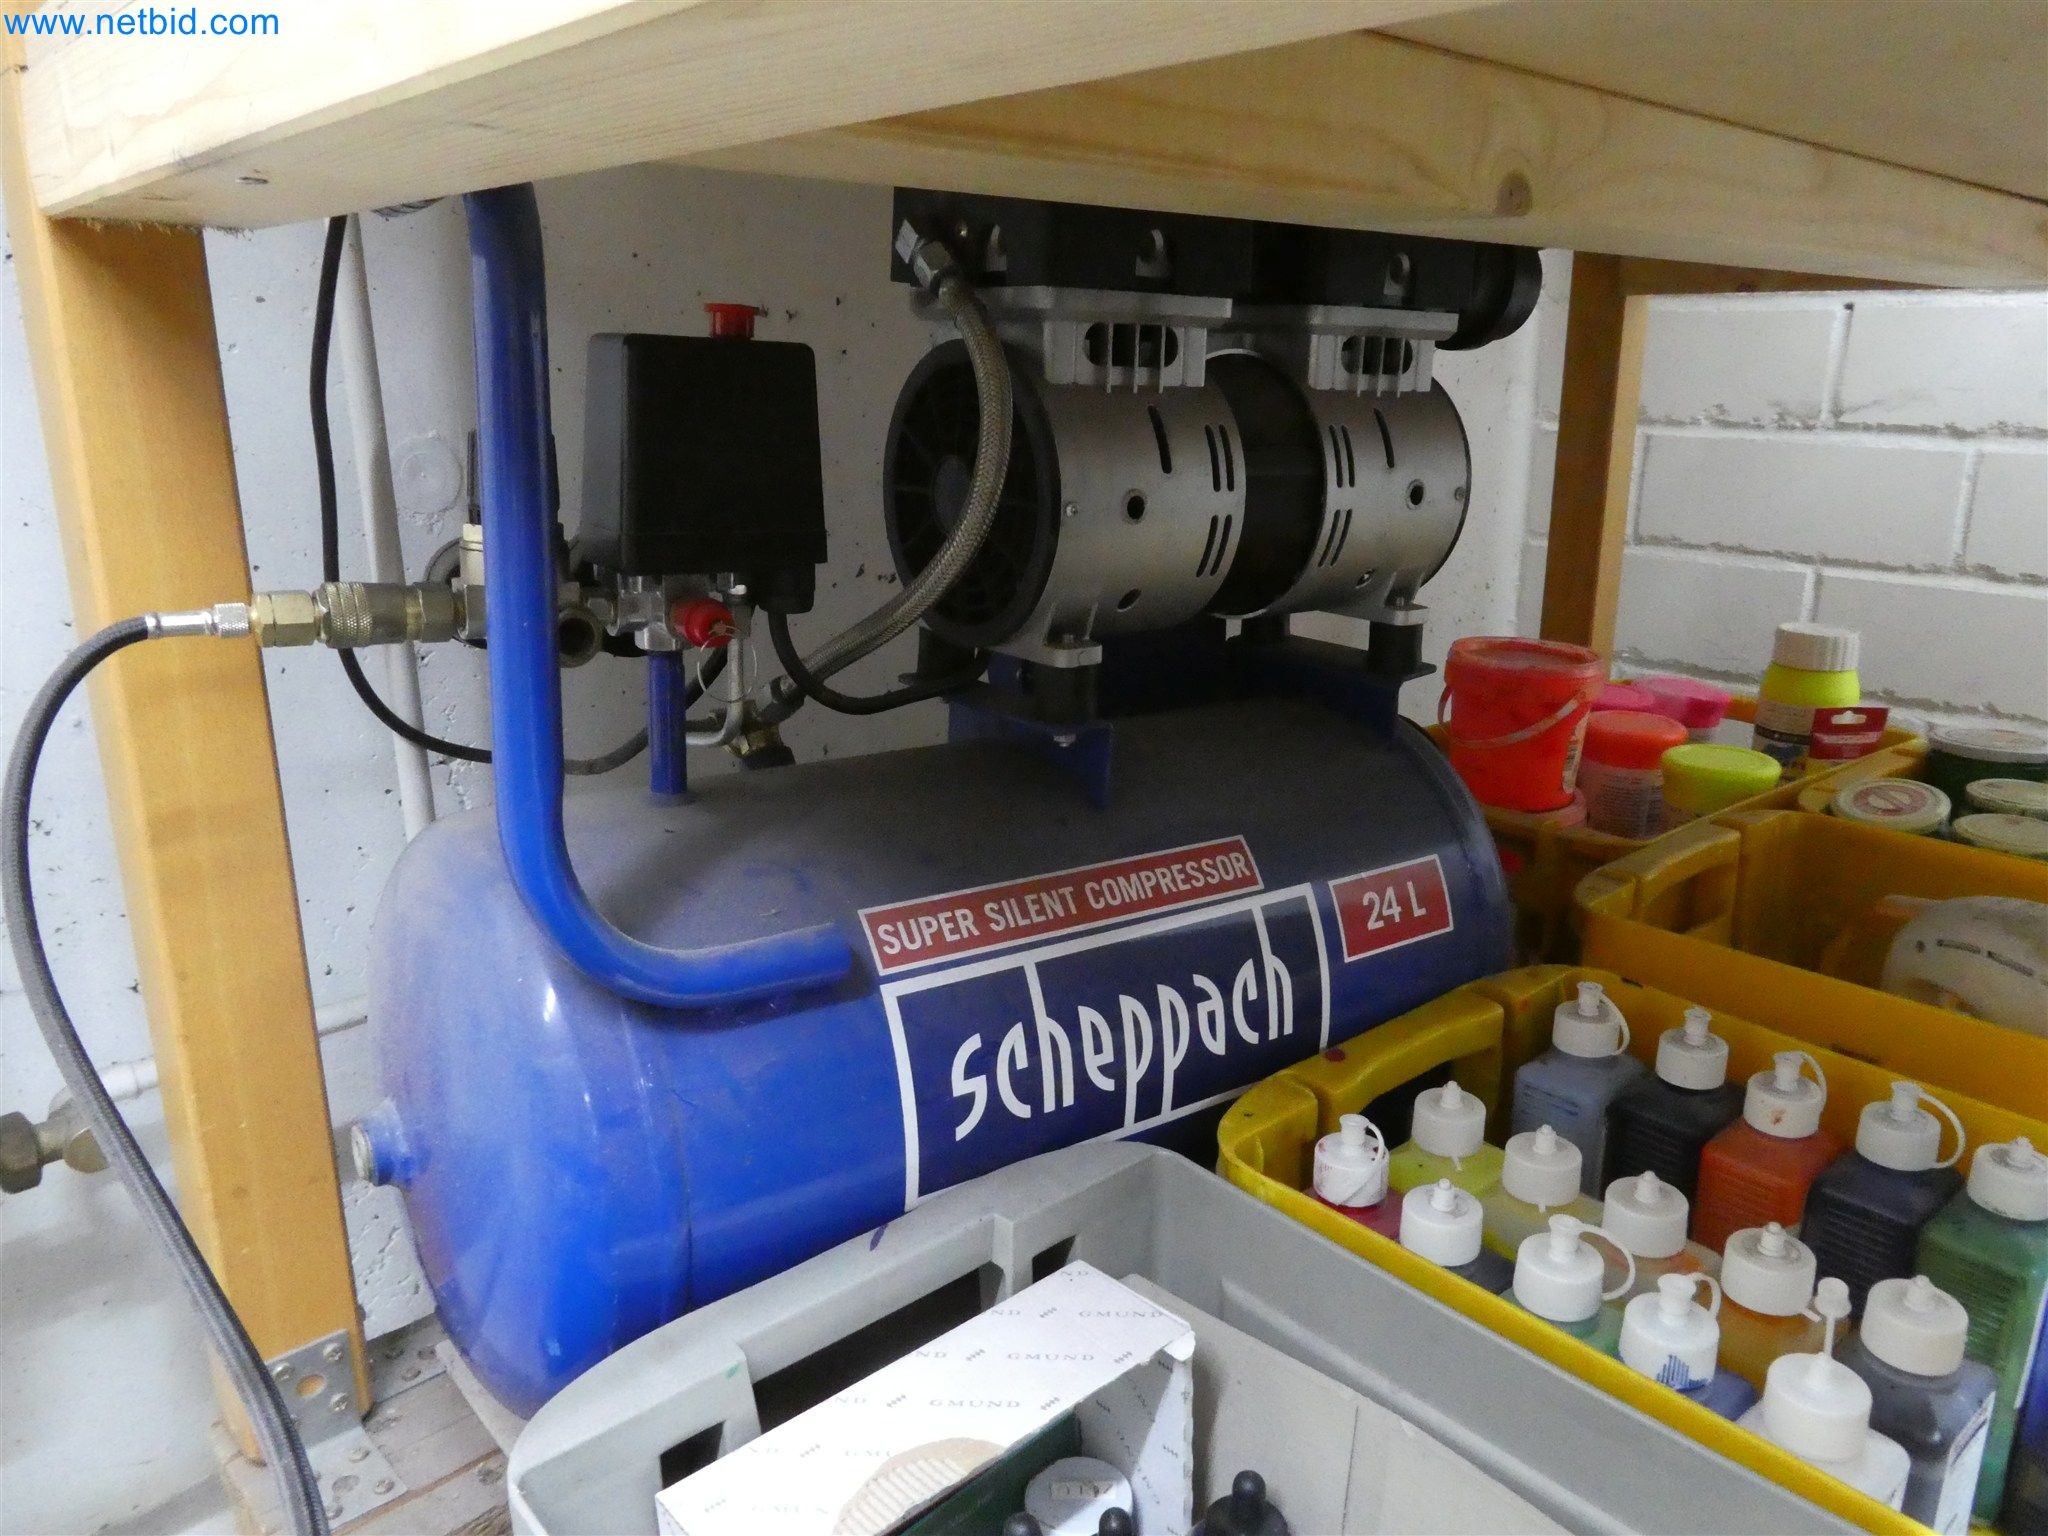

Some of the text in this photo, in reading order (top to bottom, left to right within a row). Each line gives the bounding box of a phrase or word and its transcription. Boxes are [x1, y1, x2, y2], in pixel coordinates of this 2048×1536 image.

[877, 851, 1252, 955] SUPER SILENT COMPRESSOR
[1362, 880, 1428, 931] 24 L
[950, 906, 1294, 1142] scheppach
[1078, 1310, 1165, 1318] GMUND
[1006, 1353, 1095, 1361] GMUND
[929, 1399, 1022, 1408] GMUND
